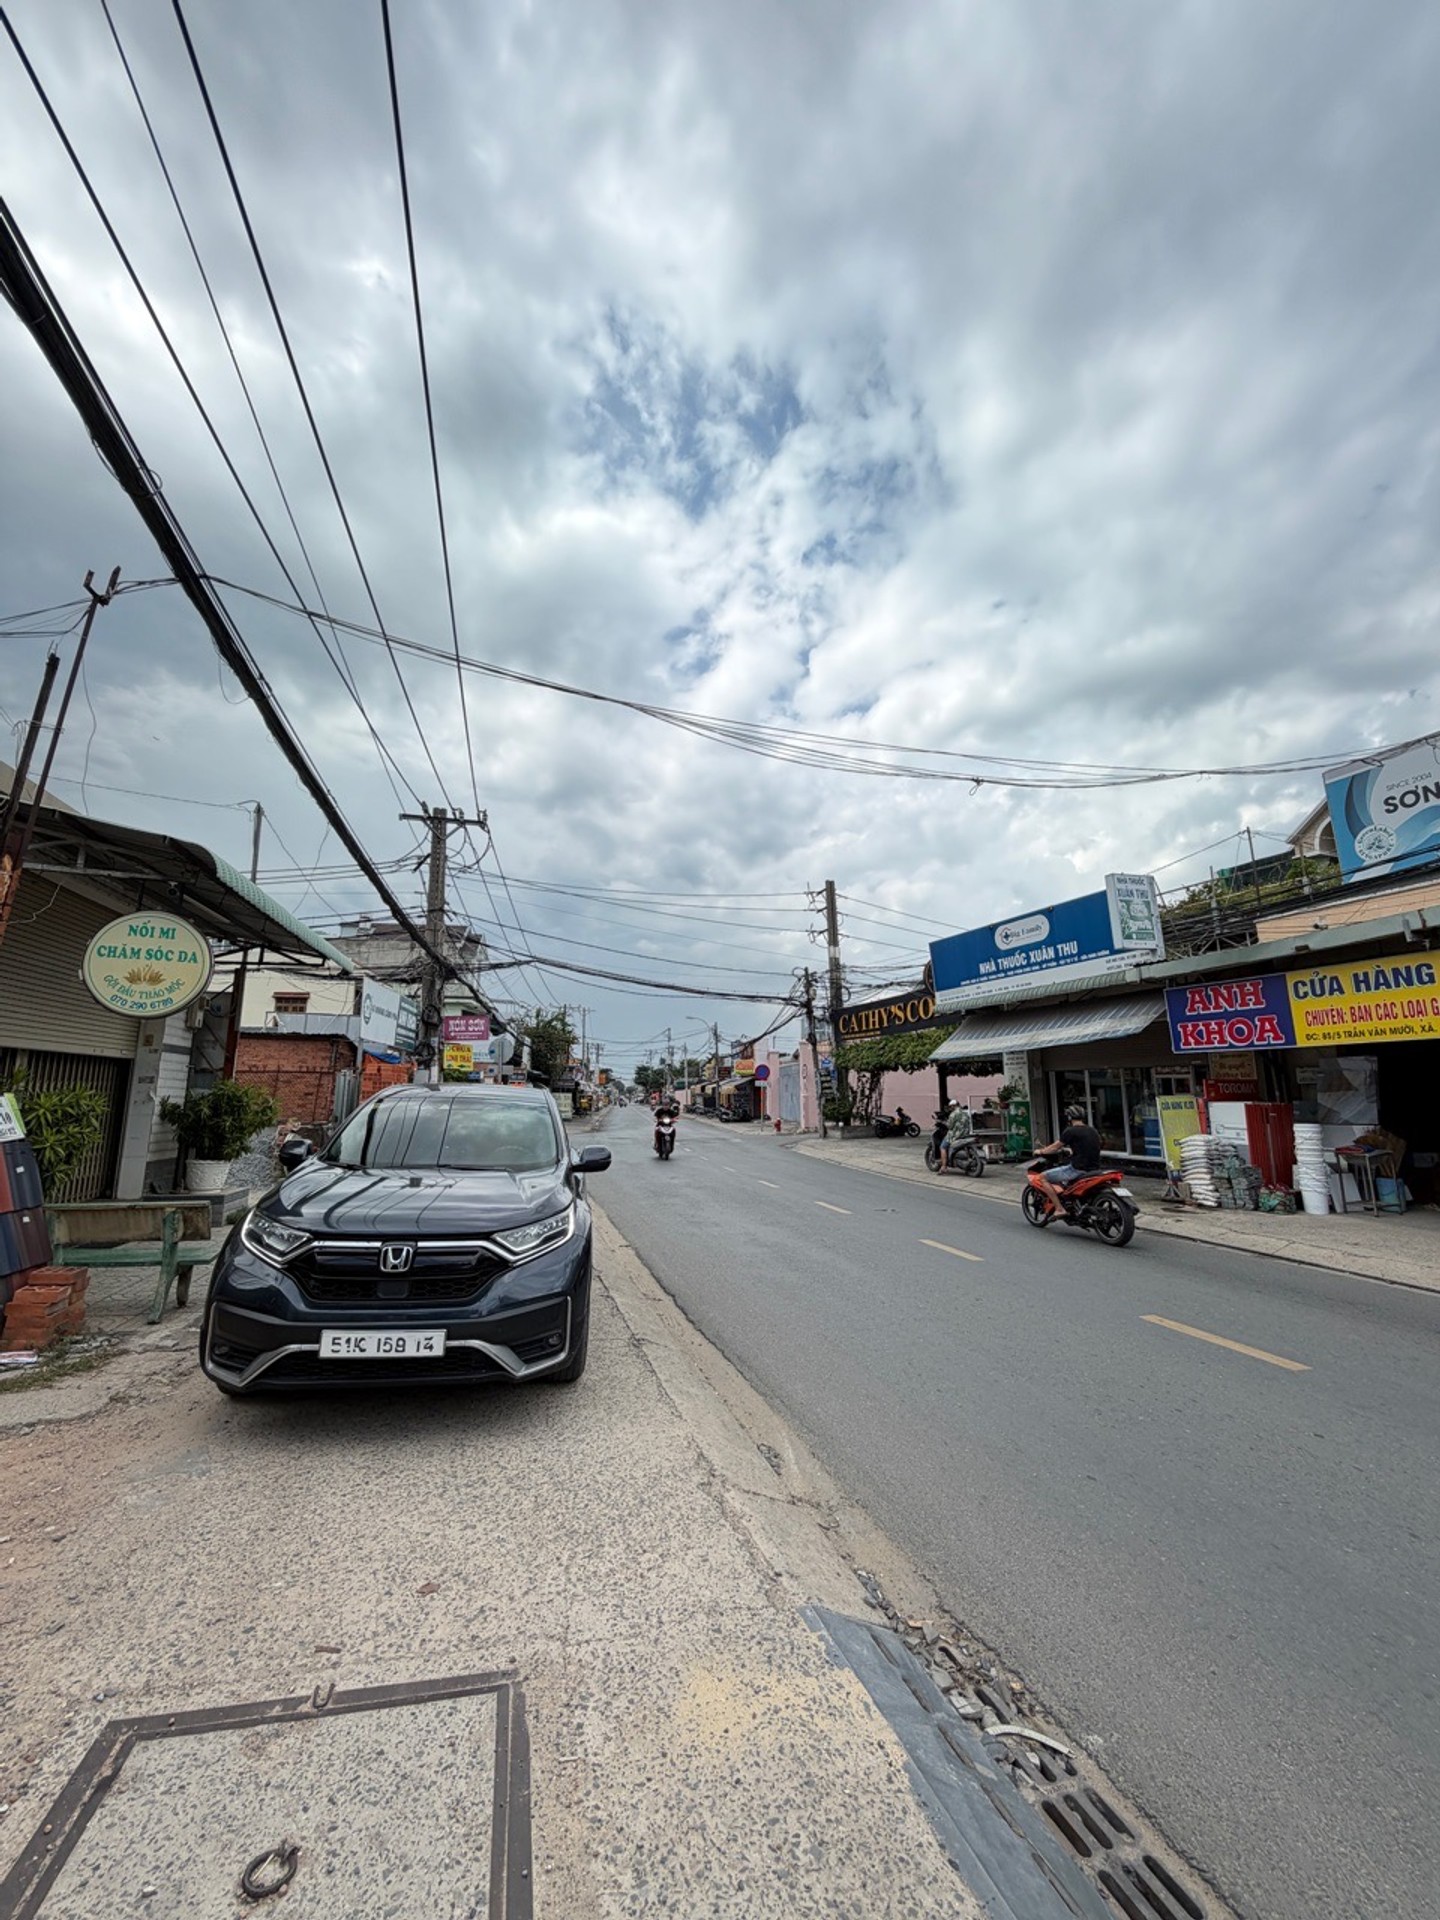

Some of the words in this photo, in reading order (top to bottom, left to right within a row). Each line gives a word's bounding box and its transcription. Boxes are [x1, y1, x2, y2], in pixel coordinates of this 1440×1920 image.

[1386, 779, 1410, 791] SINCE
[1411, 771, 1432, 784] 2004
[1383, 781, 1440, 815] SƠN
[128, 920, 156, 938] NỐI
[158, 927, 177, 939] MI
[96, 943, 142, 960] CHĂM
[144, 945, 174, 961] SÓC
[177, 951, 199, 964] DA
[979, 957, 997, 975] NHÀ
[997, 949, 1028, 970] THUỐC
[1028, 945, 1055, 964] XUÂN
[1057, 940, 1079, 957] THU
[1293, 970, 1345, 1001] CỬA
[1352, 962, 1436, 994] HÀNG
[1186, 979, 1266, 1014] ANH
[1305, 1004, 1348, 1027] CHUYÊN:
[1349, 1001, 1373, 1023] BÁN
[1375, 998, 1398, 1020] CÁC
[1400, 999, 1428, 1022] LOẠI
[1179, 1014, 1285, 1049] KHOA
[1343, 1026, 1366, 1039] TRẦN
[1368, 1027, 1387, 1038] VĂN
[331, 1336, 367, 1353] 51K
